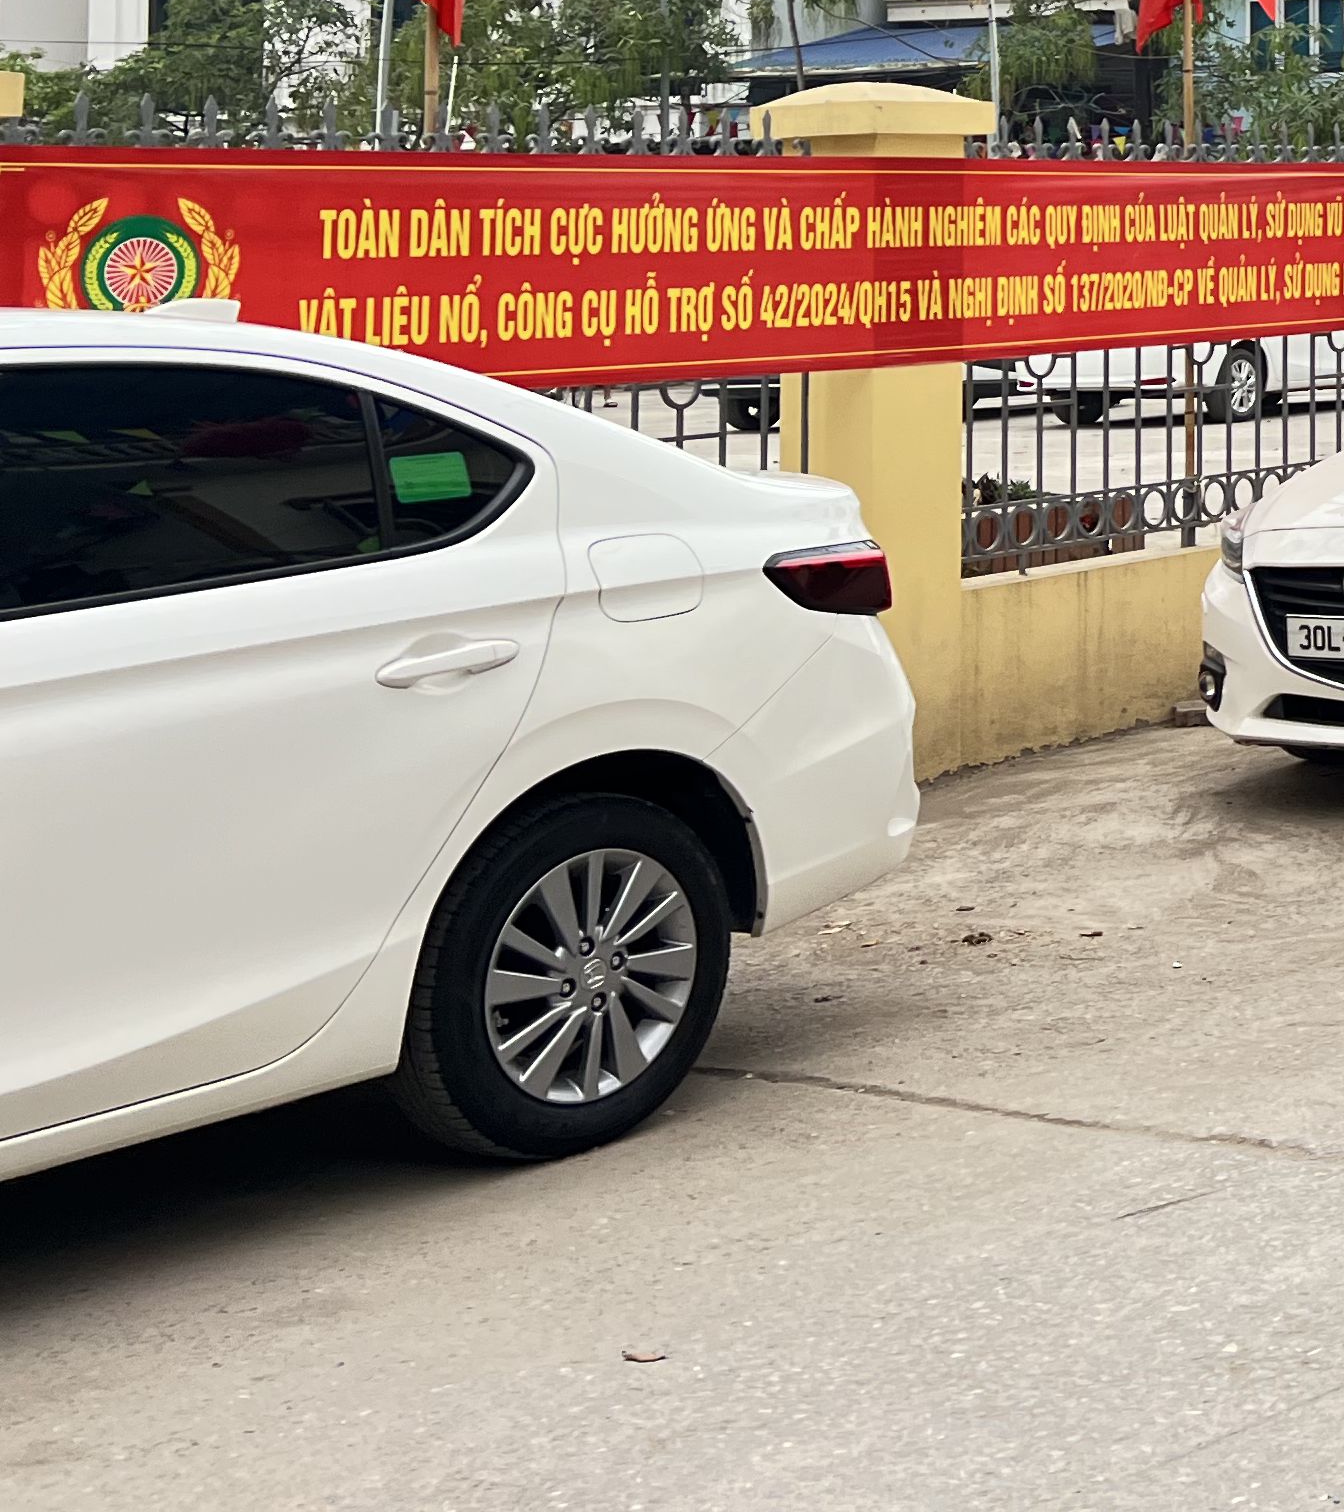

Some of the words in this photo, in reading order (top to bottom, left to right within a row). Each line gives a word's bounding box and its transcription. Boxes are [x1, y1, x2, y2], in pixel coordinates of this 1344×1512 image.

[320, 198, 400, 260] TOÀN
[409, 198, 471, 258] DÂN
[479, 198, 542, 257] TÍCH
[550, 203, 604, 265] CỰC
[611, 192, 699, 254] HƯỞNG
[706, 197, 756, 253] ỨNG
[763, 197, 793, 251] VÀ
[800, 191, 861, 251] CHẤP
[866, 197, 923, 249] HÀNH
[928, 197, 1002, 247] NGHIÊM
[1006, 196, 1041, 246] CÁC
[1045, 205, 1078, 249] QUY
[1081, 205, 1121, 252] ĐỊNH
[1124, 192, 1156, 243] CỦA
[1159, 196, 1196, 249] LUẬT
[1199, 191, 1239, 245] QUẢN
[1242, 195, 1263, 243] LÝ,
[1265, 191, 1286, 239] SỬ
[1287, 202, 1324, 245] DỤNG
[1326, 195, 1343, 237] VŨ
[438, 274, 488, 348] NỔ,
[497, 282, 574, 342] CÔNG
[581, 289, 617, 347] CỤ
[624, 272, 660, 335] HỖ
[666, 281, 715, 342] TRỢ
[721, 269, 755, 331] SỐ
[759, 280, 912, 329] 42/2024/QH15
[917, 270, 943, 321] VÀ
[948, 276, 993, 327] NGHỊ
[997, 275, 1039, 325] ĐỊNH
[1042, 259, 1066, 315] SỐ
[1070, 268, 1194, 313] 137/2020/NĐ-CP
[1197, 256, 1215, 305] VỀ
[1218, 254, 1258, 308] QUẢN
[1260, 257, 1281, 304] LÝ,
[1283, 252, 1304, 300] SỬ
[1304, 262, 1340, 306] DỤNG
